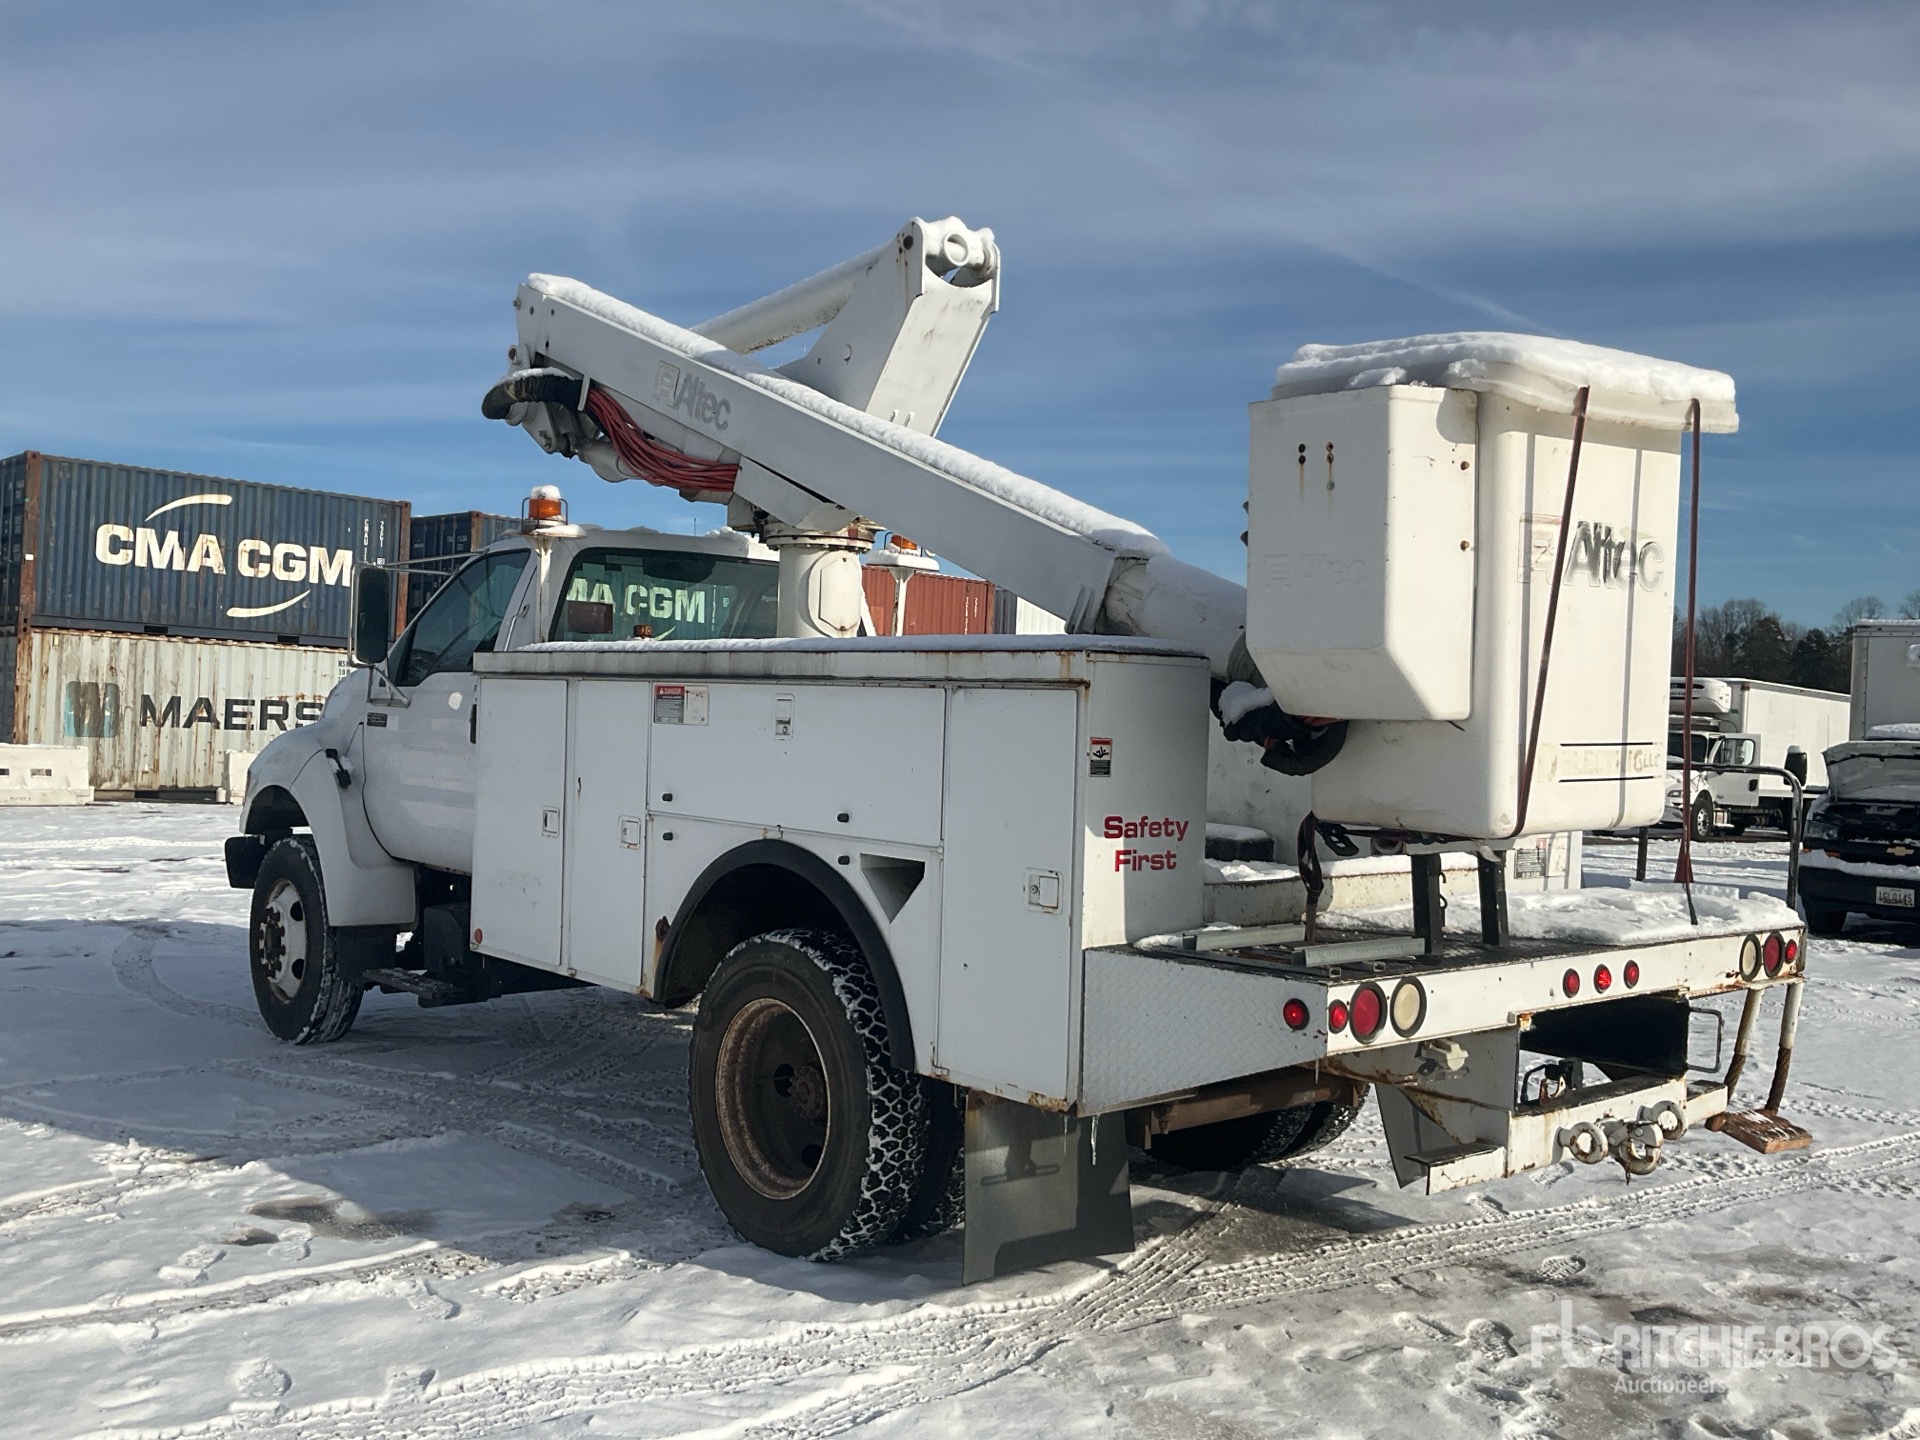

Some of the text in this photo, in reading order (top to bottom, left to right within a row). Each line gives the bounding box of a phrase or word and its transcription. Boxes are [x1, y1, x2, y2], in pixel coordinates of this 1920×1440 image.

[673, 372, 731, 431] Altec
[95, 523, 353, 588] CMA CGM
[1562, 519, 1665, 592] Altec
[625, 584, 706, 624] CGM
[1104, 816, 1188, 841] Safety
[1115, 849, 1177, 872] First
